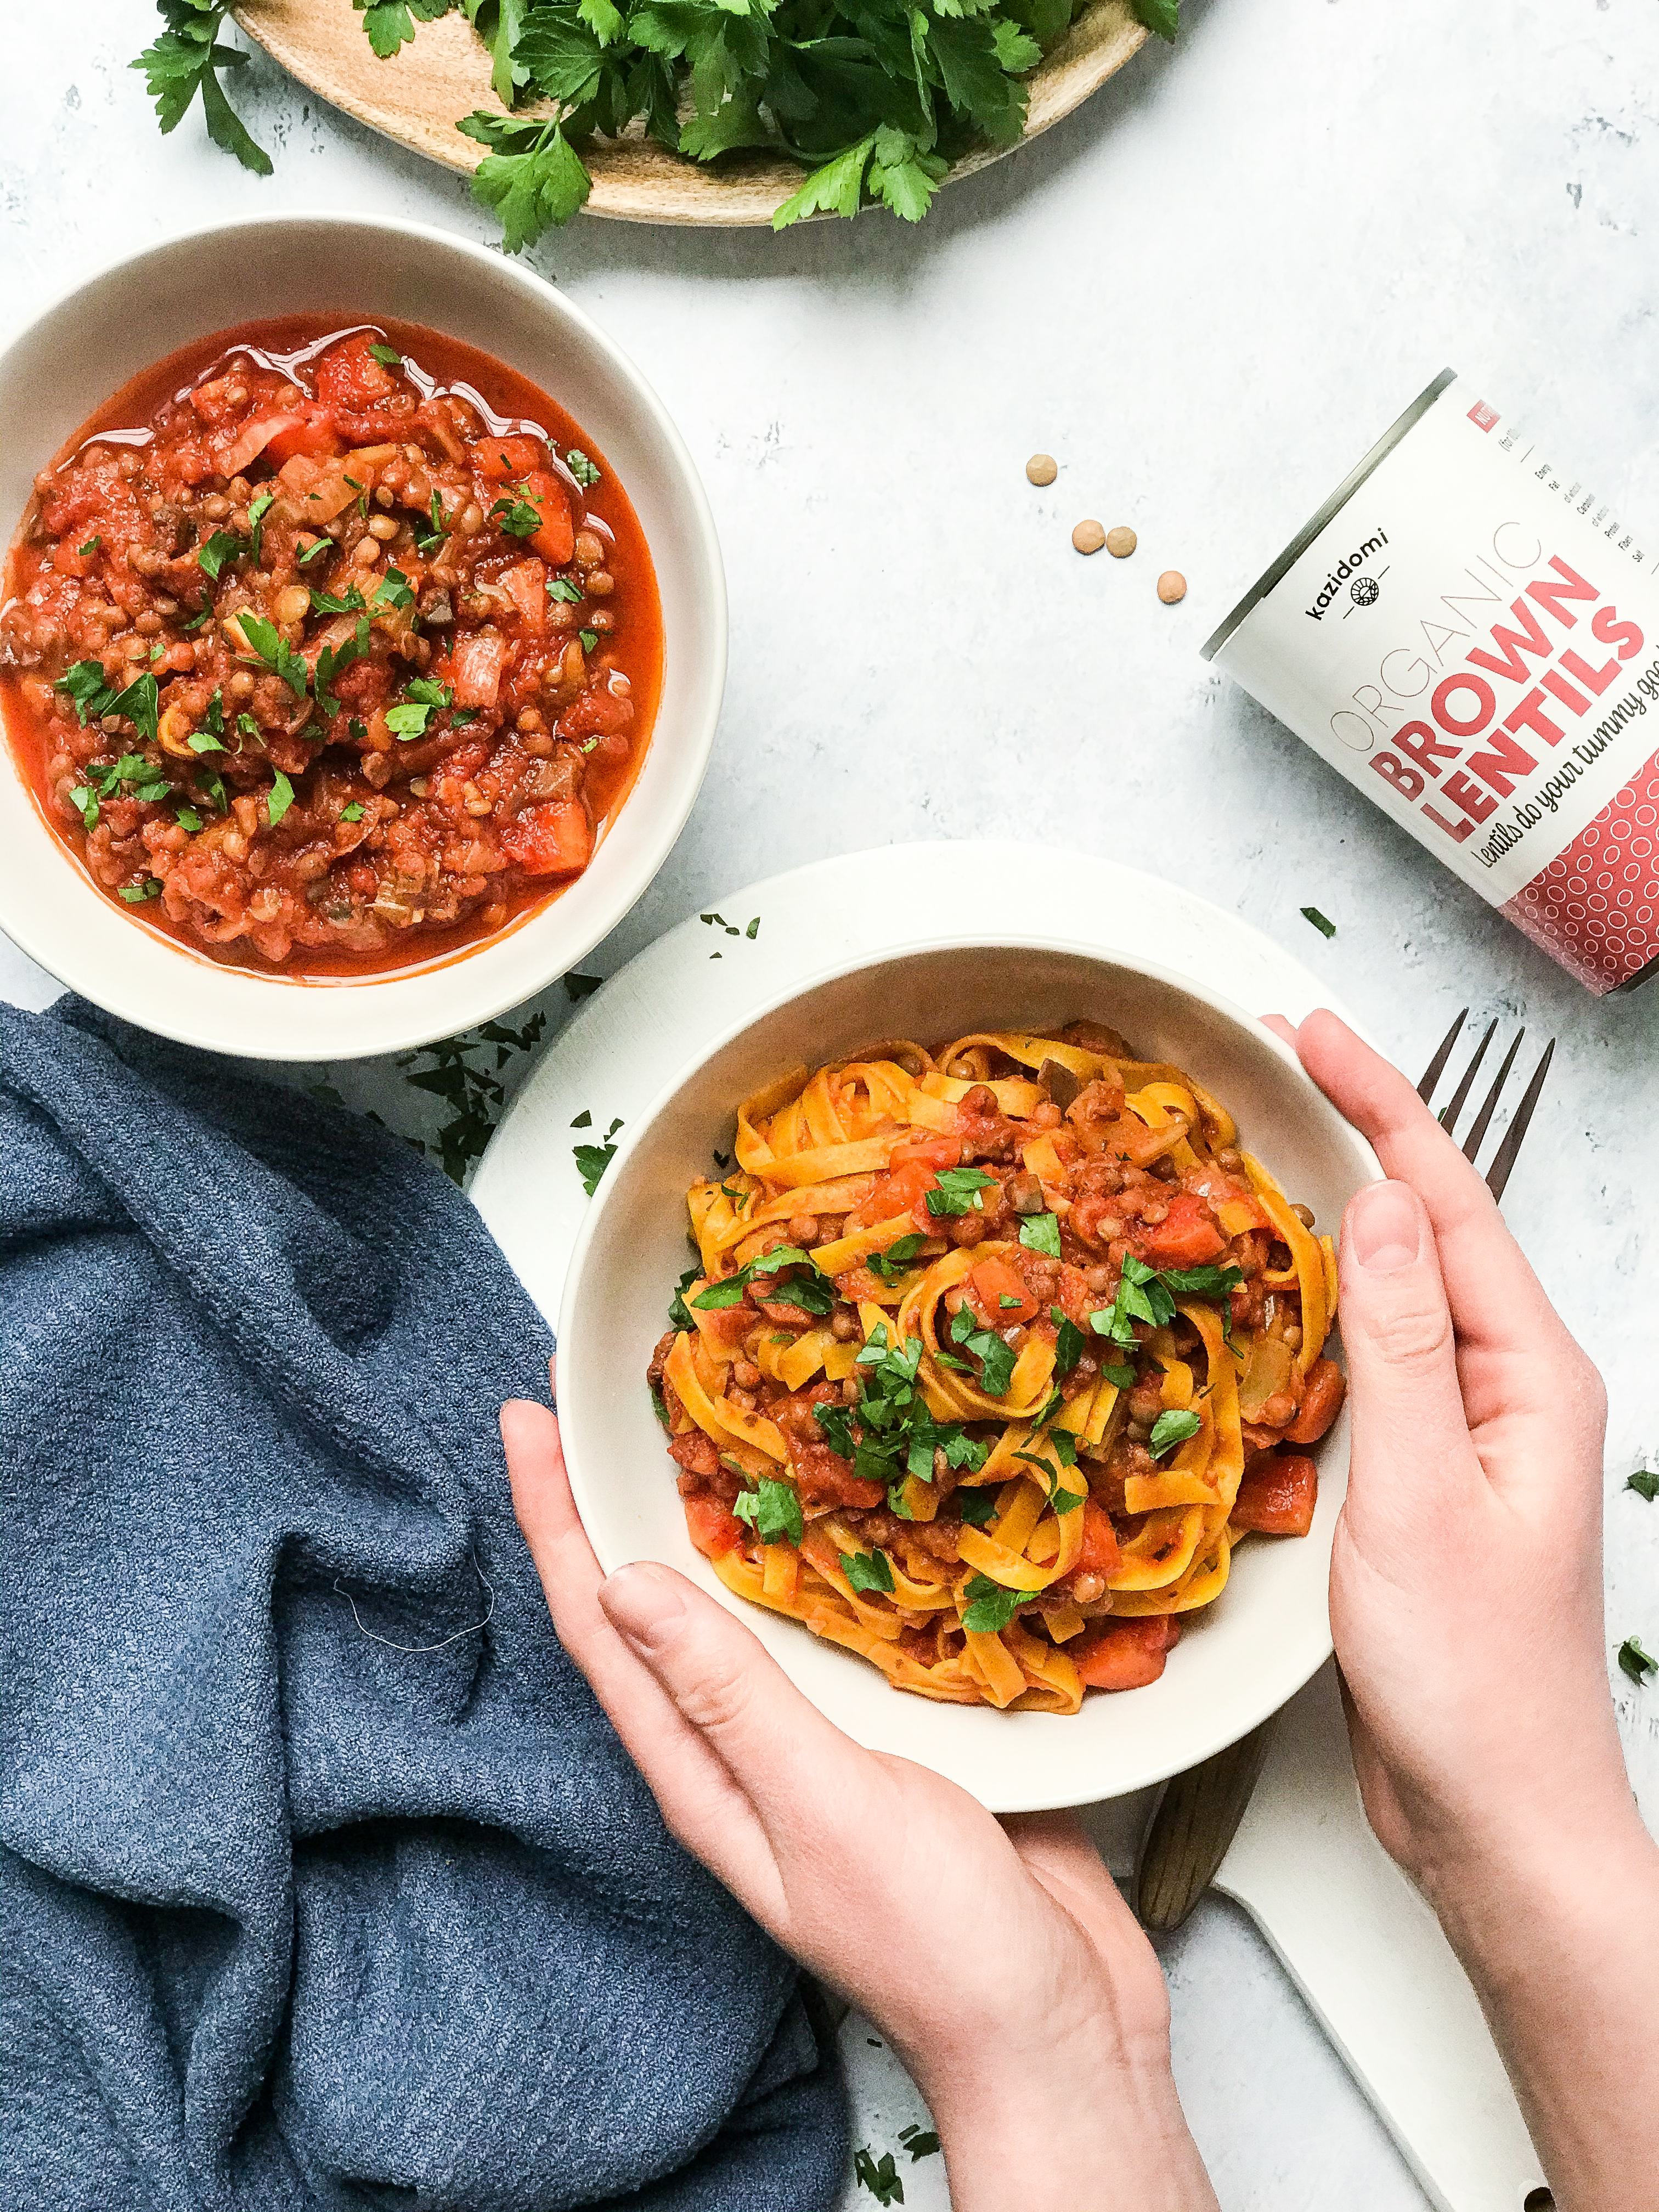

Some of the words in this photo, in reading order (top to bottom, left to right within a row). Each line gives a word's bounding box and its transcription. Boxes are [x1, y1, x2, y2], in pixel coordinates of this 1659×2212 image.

[1305, 527, 1389, 621] kazidomi
[1548, 480, 1560, 492] Fat
[1330, 522, 1542, 752] ORGANIC
[1368, 554, 1601, 802] BROWN
[1420, 606, 1644, 844] LENTILS
[1470, 822, 1523, 868] Lentils
[1512, 803, 1542, 829] do
[1534, 761, 1583, 813] your
[1572, 692, 1647, 765] tummy
